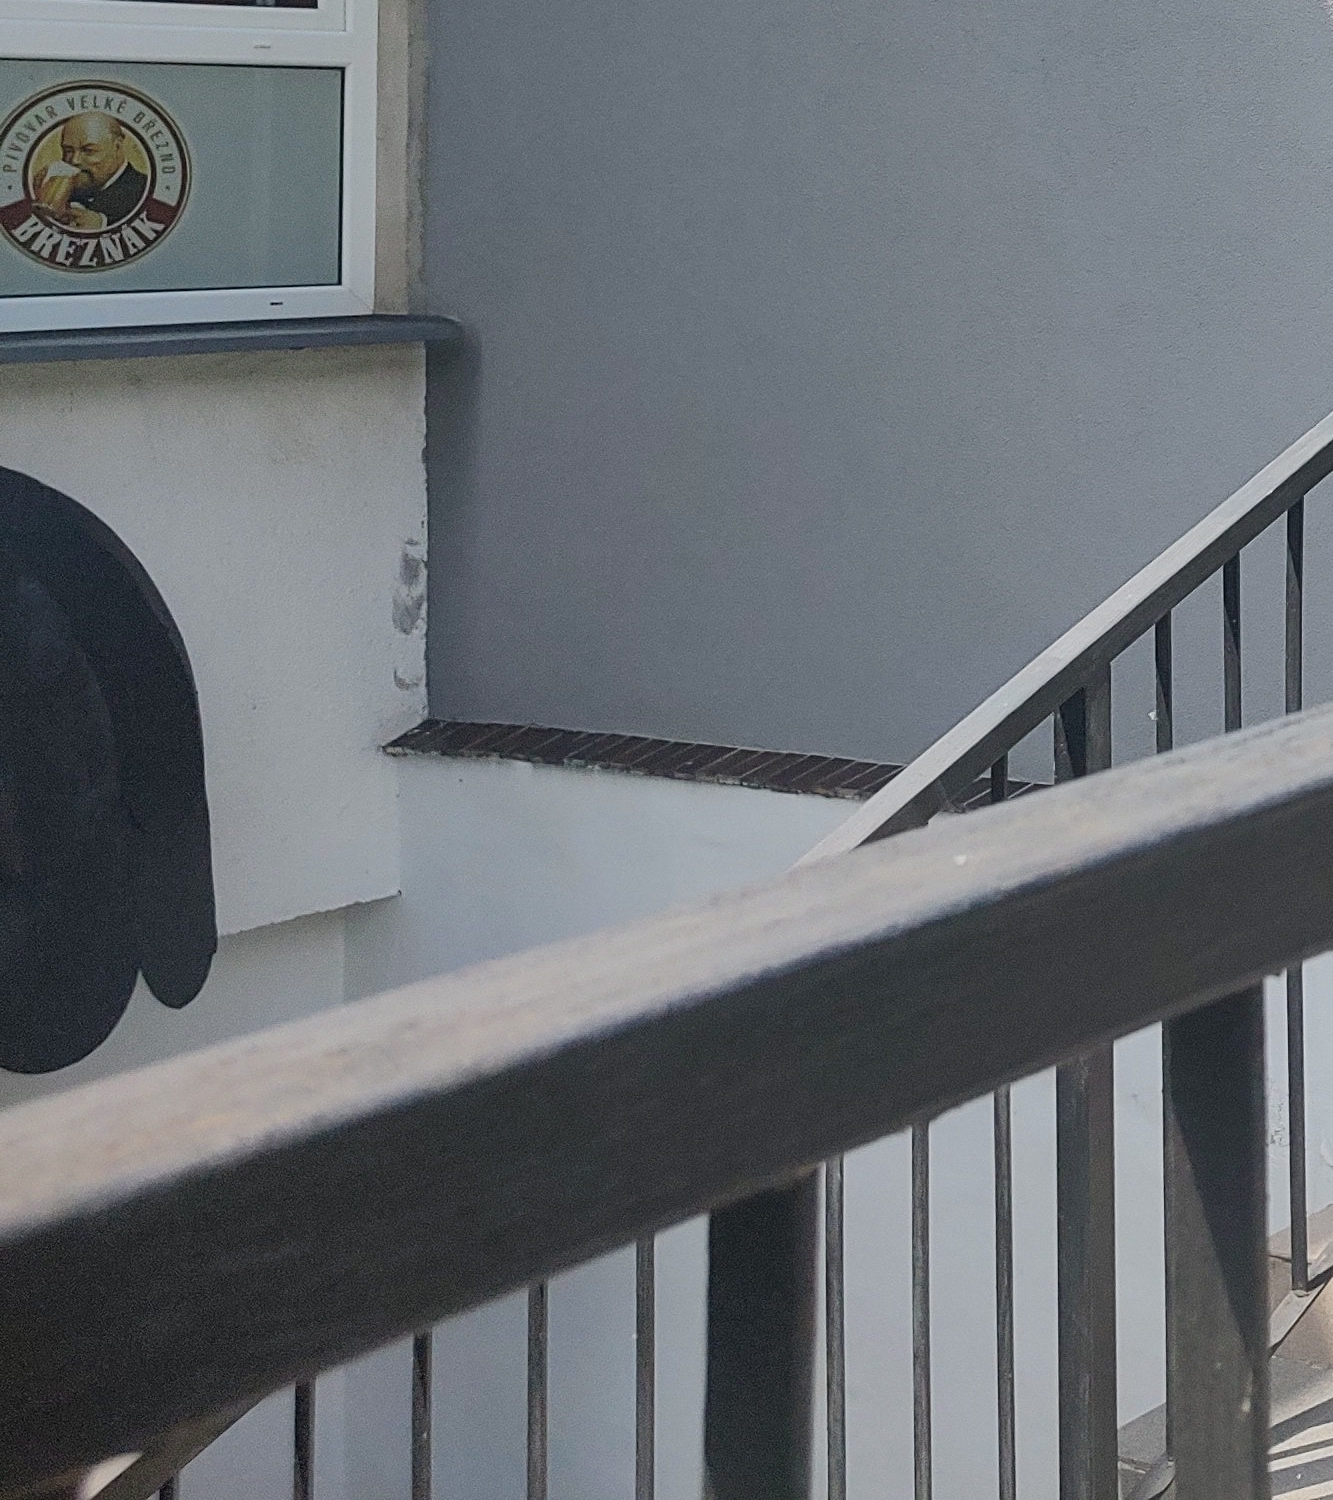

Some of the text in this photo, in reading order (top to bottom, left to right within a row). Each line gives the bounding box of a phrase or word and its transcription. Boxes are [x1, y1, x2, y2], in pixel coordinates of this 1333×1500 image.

[2, 94, 176, 174] PIVOVAR VELKÉ BŘEZNO
[11, 211, 165, 267] BŘEZŇÁK
